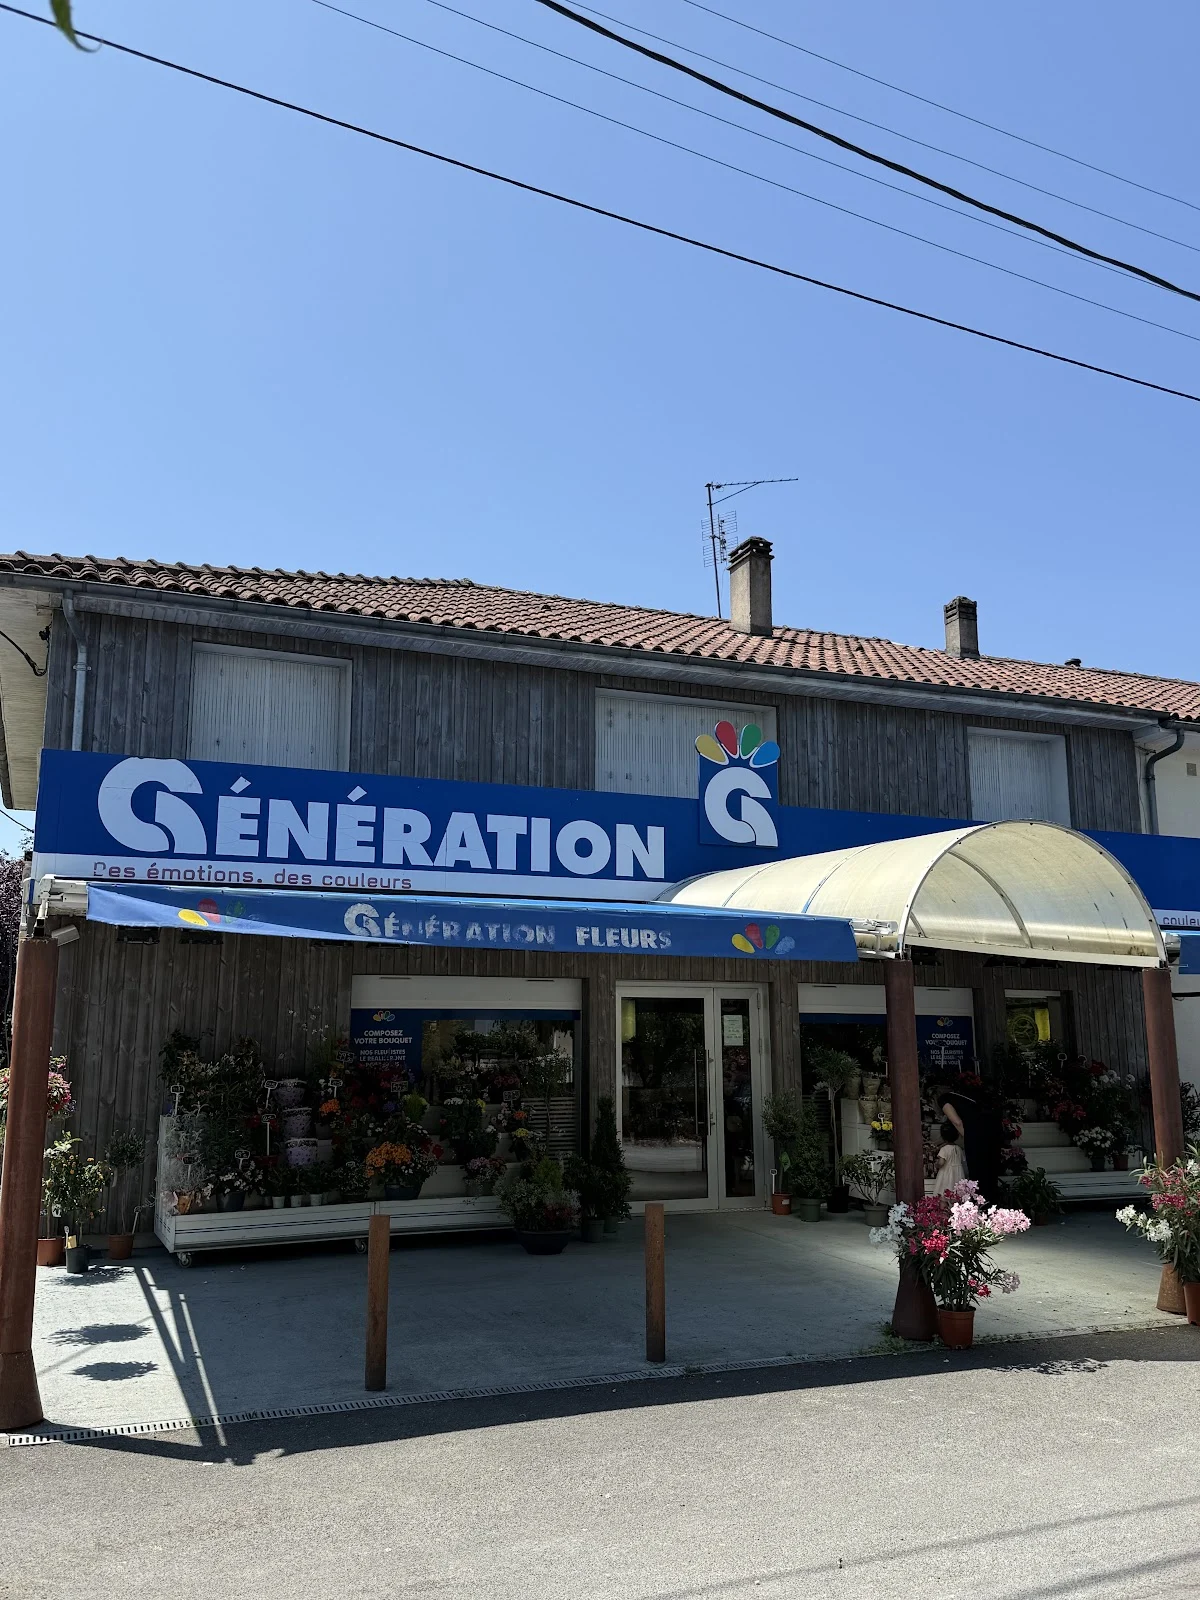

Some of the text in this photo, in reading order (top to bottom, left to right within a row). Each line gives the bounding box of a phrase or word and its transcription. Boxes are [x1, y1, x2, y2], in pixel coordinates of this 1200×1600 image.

[97, 757, 666, 879] GÉNÉRATION
[93, 861, 136, 878] Des
[274, 868, 312, 886] des
[322, 873, 412, 890] couleurs
[343, 902, 672, 949] GÉNÉRATION FLEURS
[354, 1037, 413, 1045] VOTRE BOUQUET
[363, 1029, 404, 1037] COMPOSEZ
